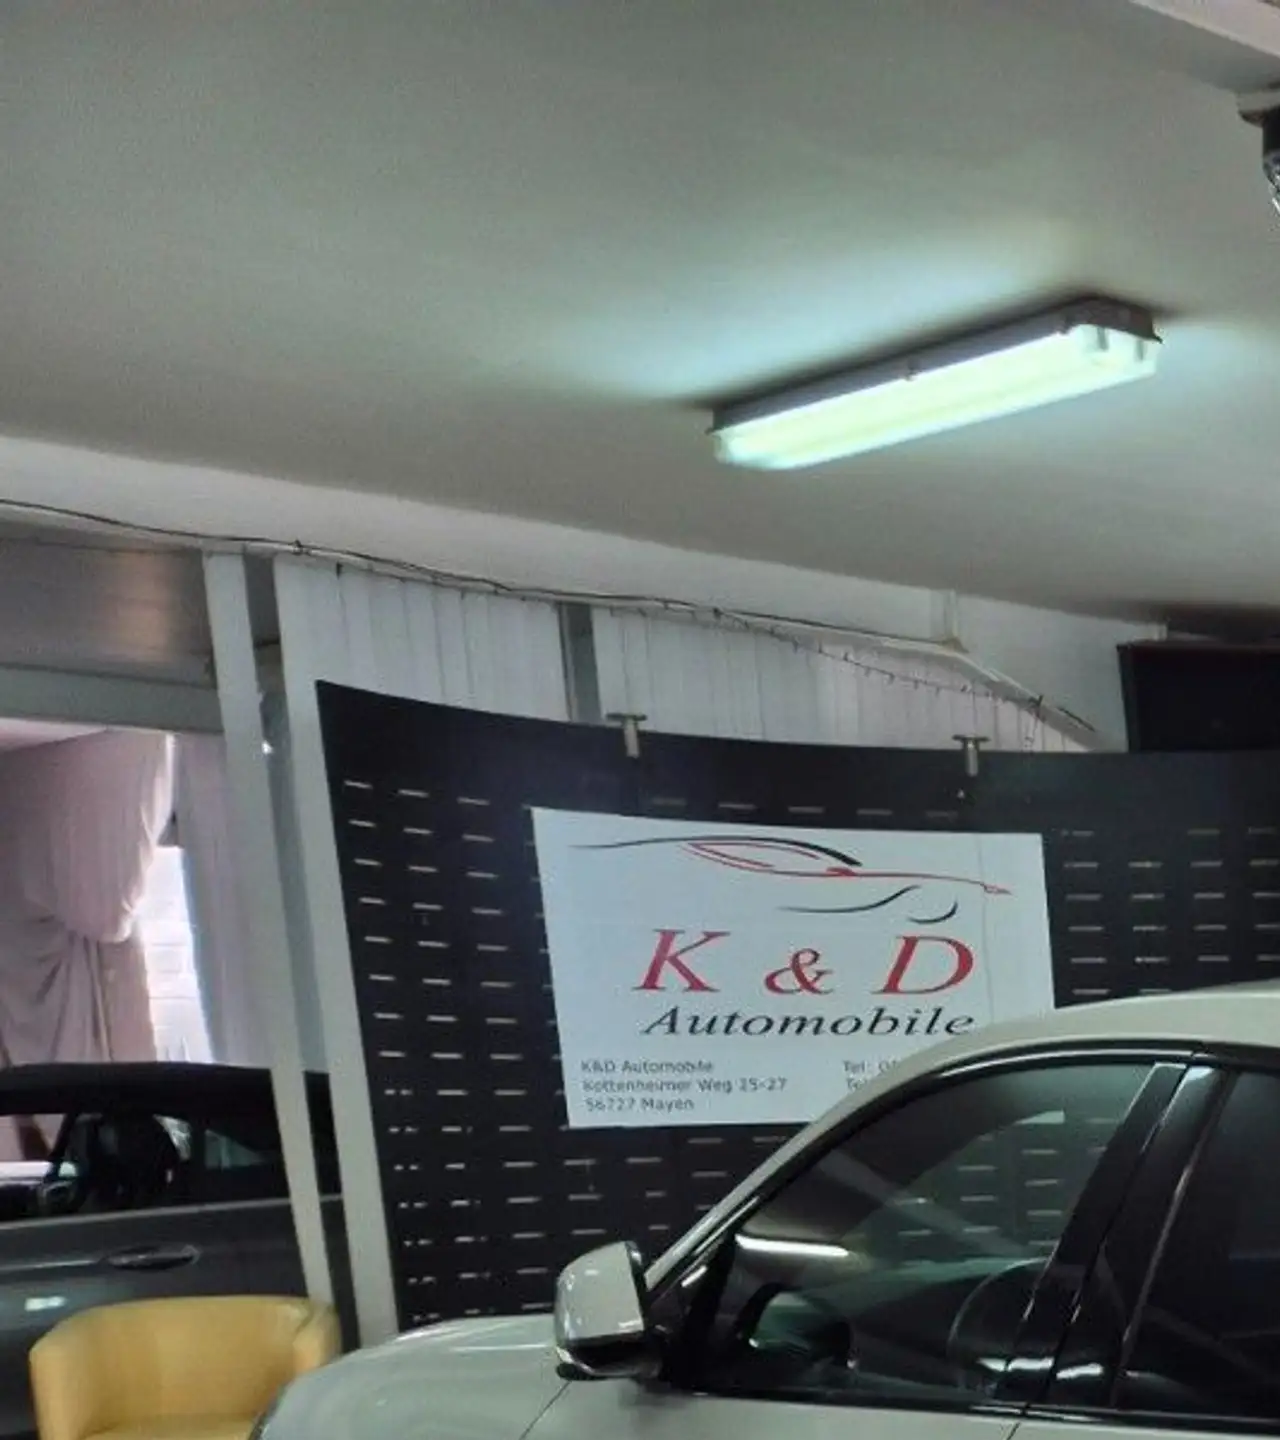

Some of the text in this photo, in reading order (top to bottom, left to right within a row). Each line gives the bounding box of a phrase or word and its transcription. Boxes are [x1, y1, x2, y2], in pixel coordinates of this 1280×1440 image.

[631, 928, 975, 995] K & D
[640, 1005, 975, 1037] Automobile
[581, 1057, 715, 1074] K&D Automobile
[697, 1077, 734, 1094] Weg
[641, 1097, 695, 1114] Mayen
